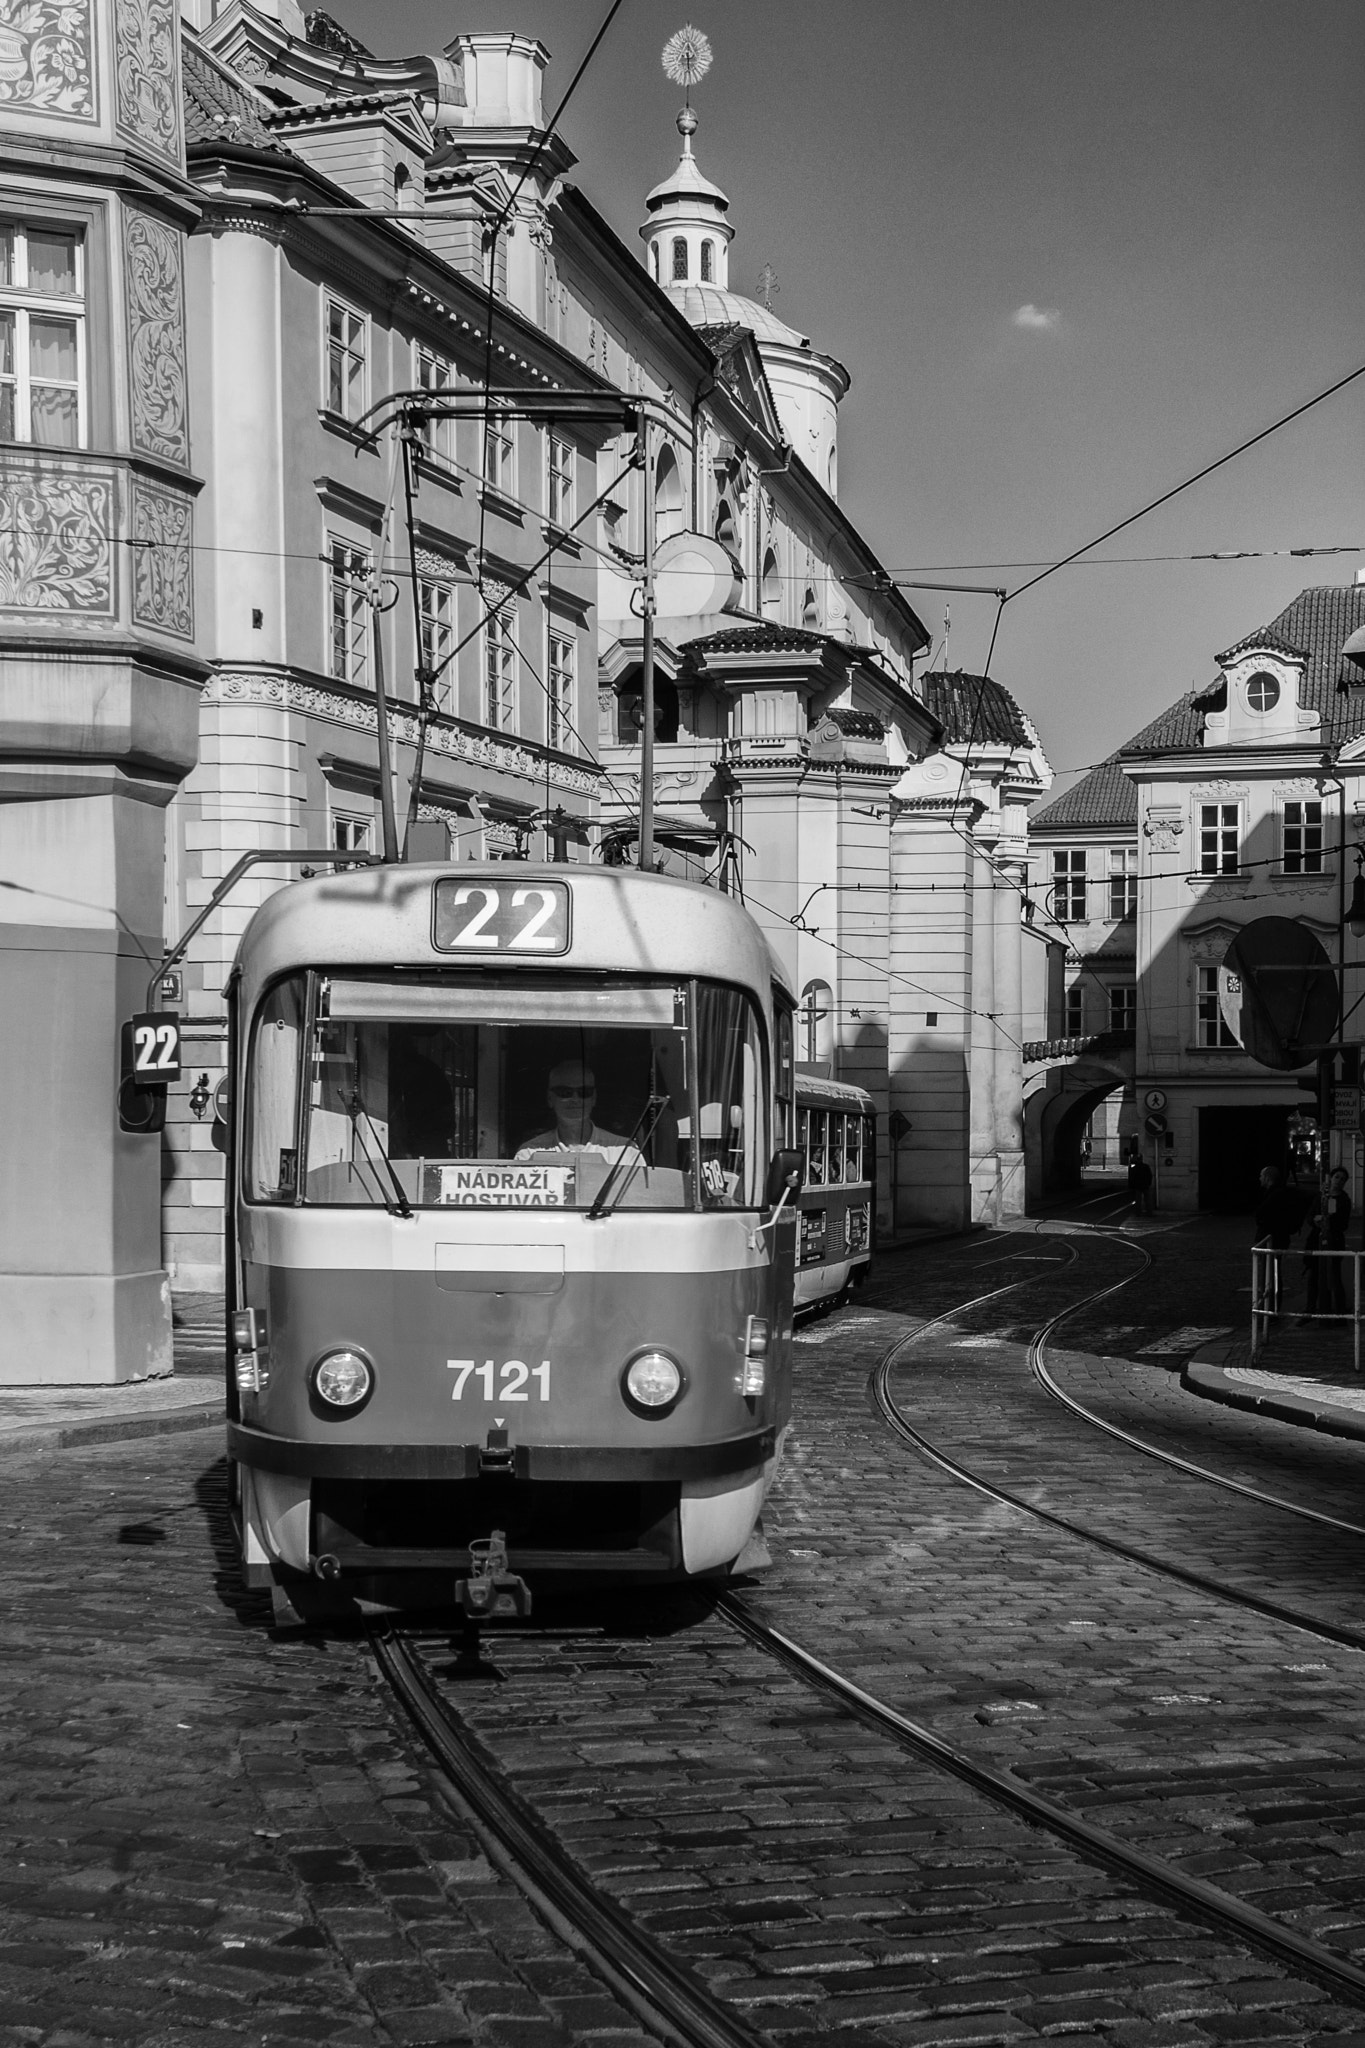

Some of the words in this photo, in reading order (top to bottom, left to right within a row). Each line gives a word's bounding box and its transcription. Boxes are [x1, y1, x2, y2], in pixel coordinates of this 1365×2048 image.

[450, 887, 557, 950] 22
[135, 1024, 179, 1071] 22
[1335, 1099, 1357, 1107] MVAJÍ
[457, 1168, 549, 1190] NÁDRAŽÍ
[702, 1159, 725, 1191] 518
[445, 1190, 559, 1206] HOSTIVAŘ
[446, 1359, 552, 1402] 7121
